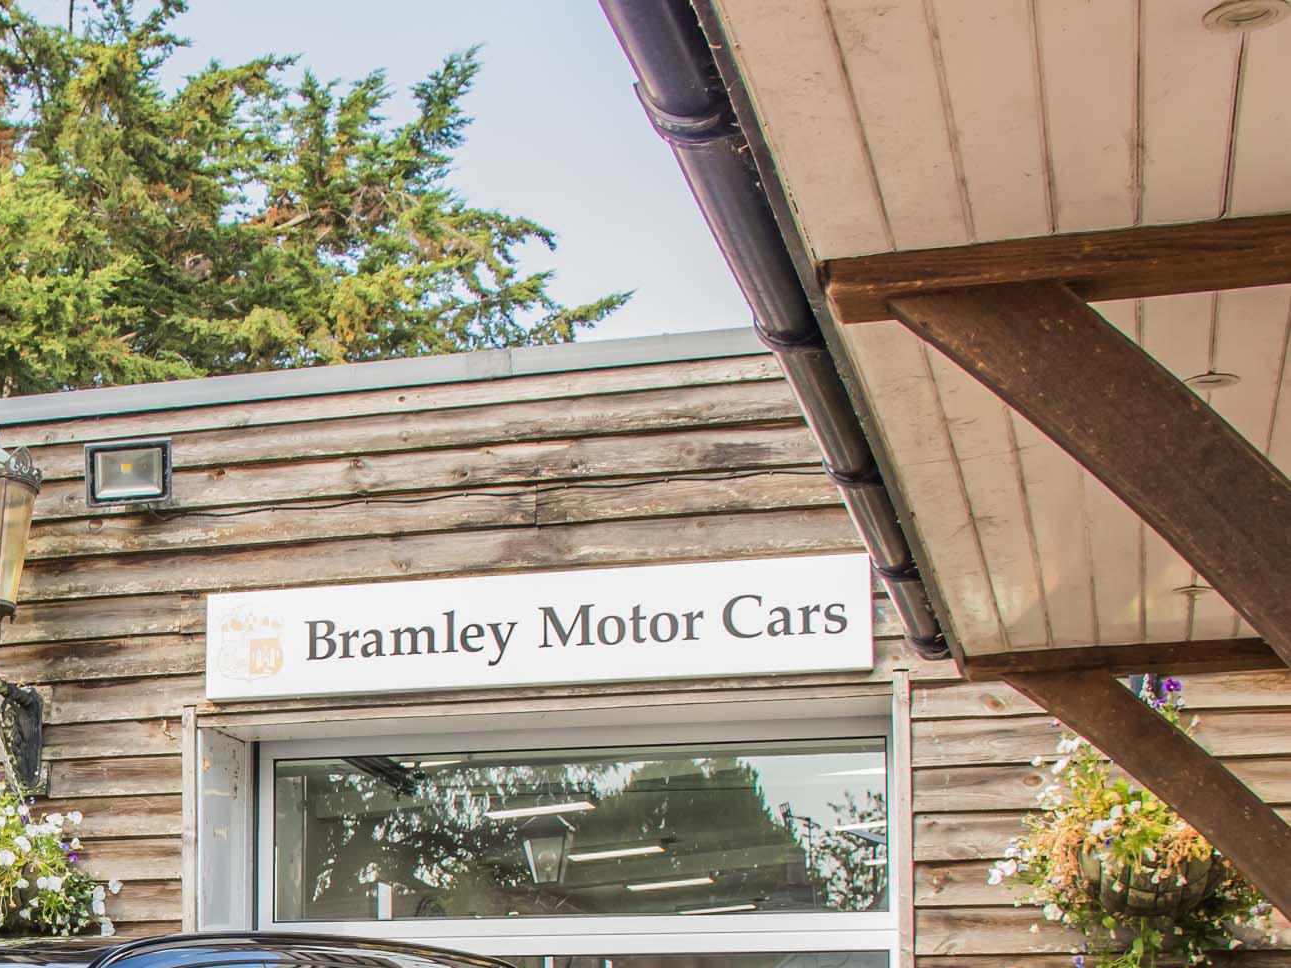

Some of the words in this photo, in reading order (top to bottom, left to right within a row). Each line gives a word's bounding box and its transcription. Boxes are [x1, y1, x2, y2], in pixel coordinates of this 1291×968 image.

[305, 609, 517, 666] Bramley
[538, 603, 704, 648] Motor
[722, 594, 848, 639] Cars
